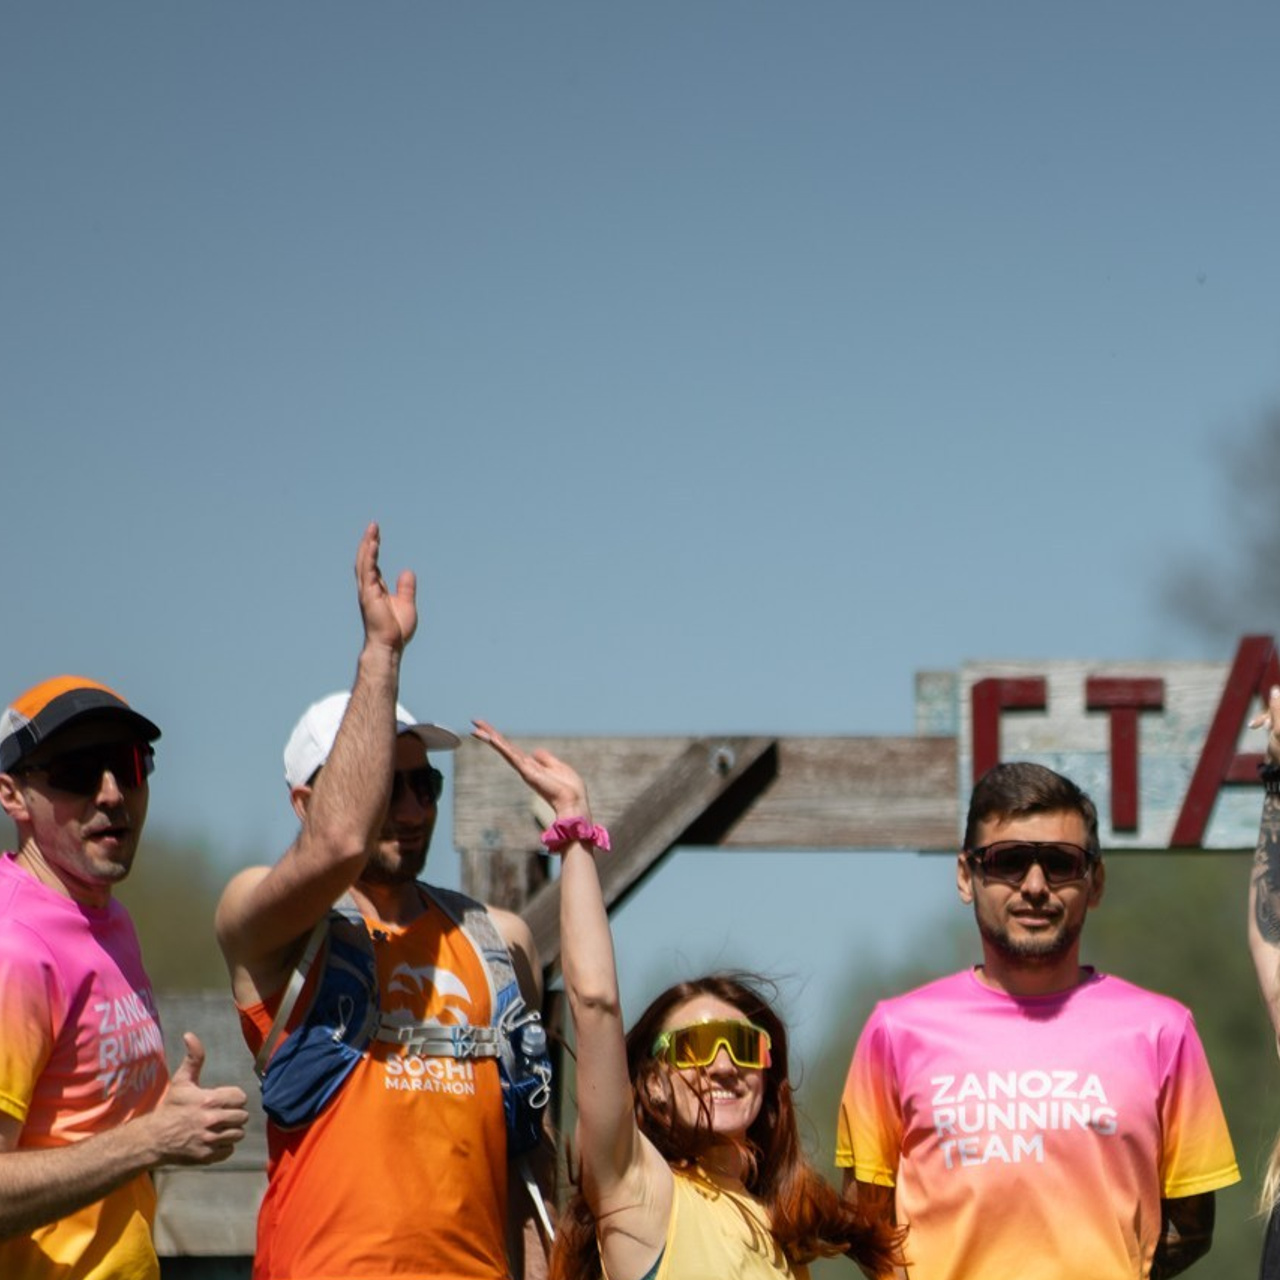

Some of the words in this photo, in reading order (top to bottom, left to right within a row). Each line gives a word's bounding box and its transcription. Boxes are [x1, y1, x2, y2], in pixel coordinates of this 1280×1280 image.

[385, 1053, 474, 1080] SOCHI
[384, 1076, 475, 1095] MARATHON
[931, 1070, 1107, 1106] ZANOZA
[932, 1100, 1118, 1137] RUNNING
[938, 1134, 1044, 1169] TEAM
